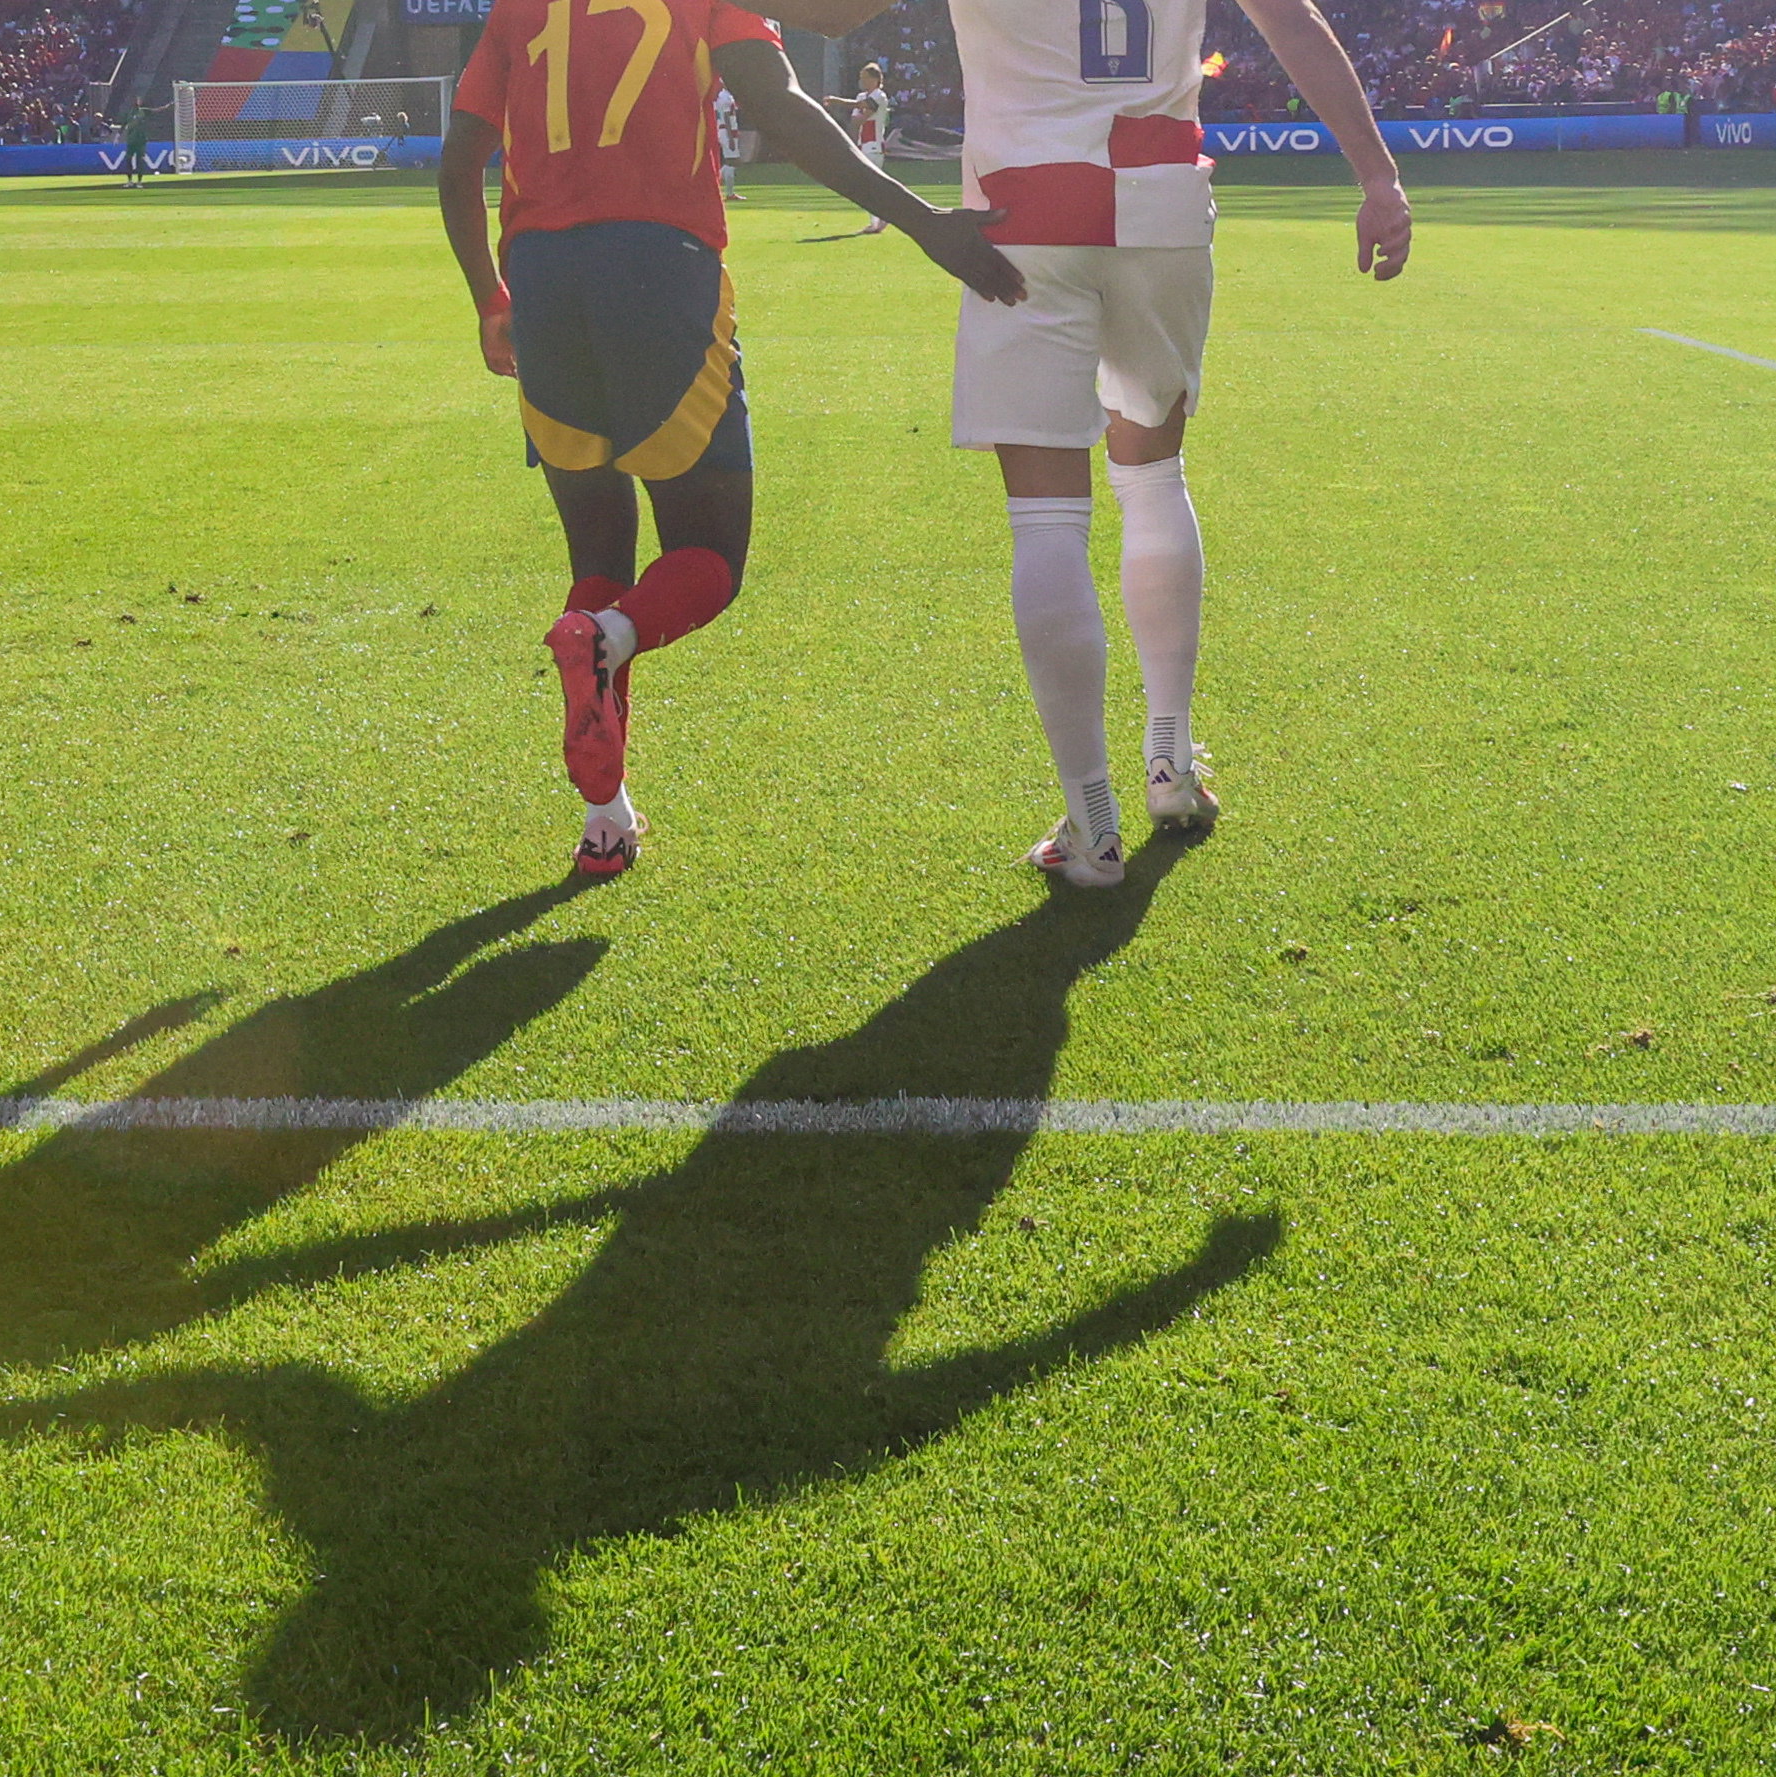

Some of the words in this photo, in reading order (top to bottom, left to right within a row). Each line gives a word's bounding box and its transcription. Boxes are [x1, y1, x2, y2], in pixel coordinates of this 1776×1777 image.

[1216, 125, 1320, 152] vivo
[1407, 123, 1514, 149] vivo
[1714, 118, 1752, 144] vivo
[281, 141, 379, 166] vivo
